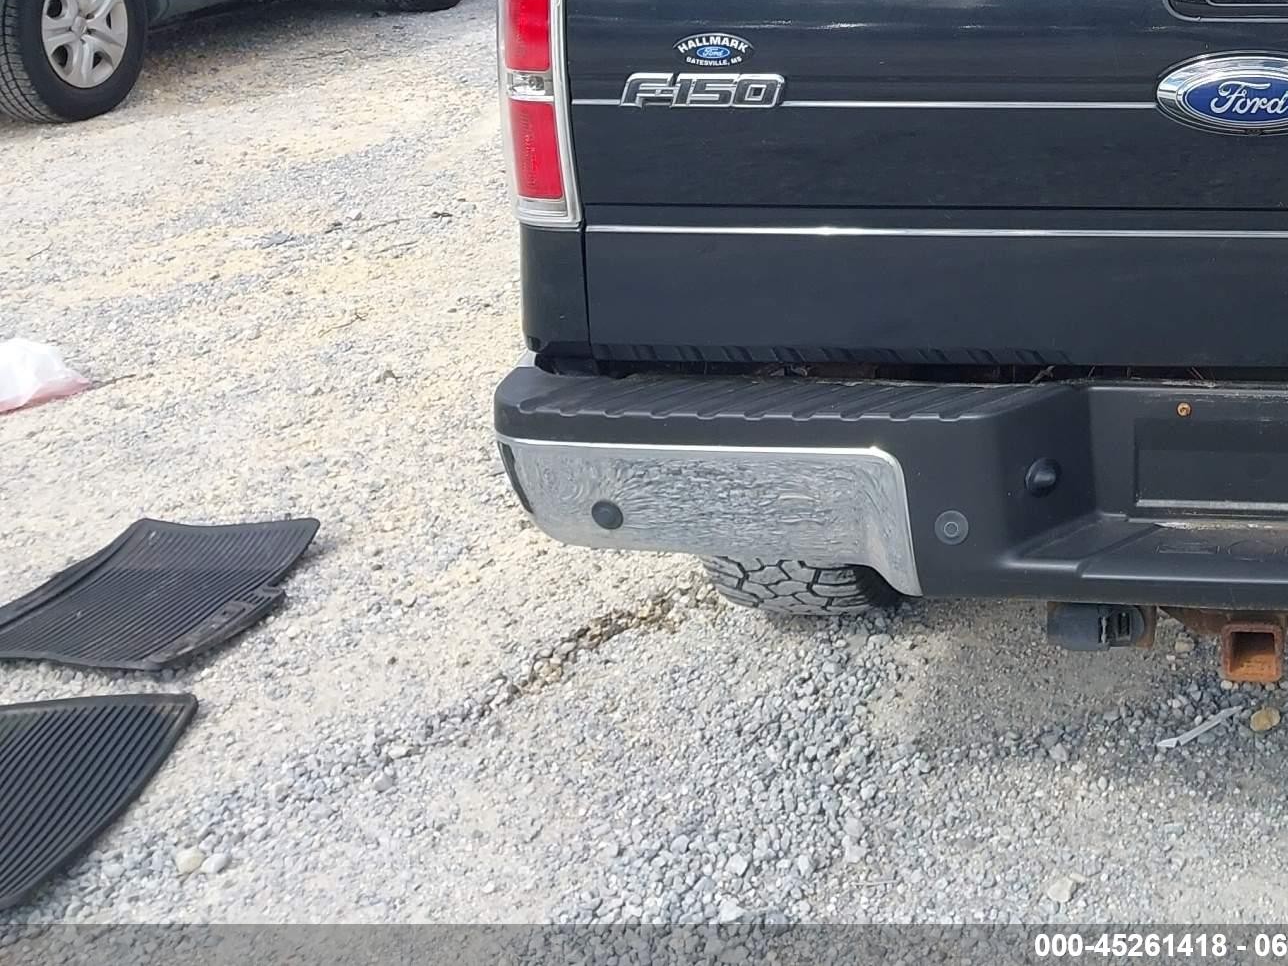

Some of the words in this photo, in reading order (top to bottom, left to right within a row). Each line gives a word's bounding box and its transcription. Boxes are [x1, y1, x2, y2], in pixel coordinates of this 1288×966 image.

[677, 36, 749, 54] HALLMARK
[730, 56, 742, 64] MS
[620, 72, 787, 109] F-150
